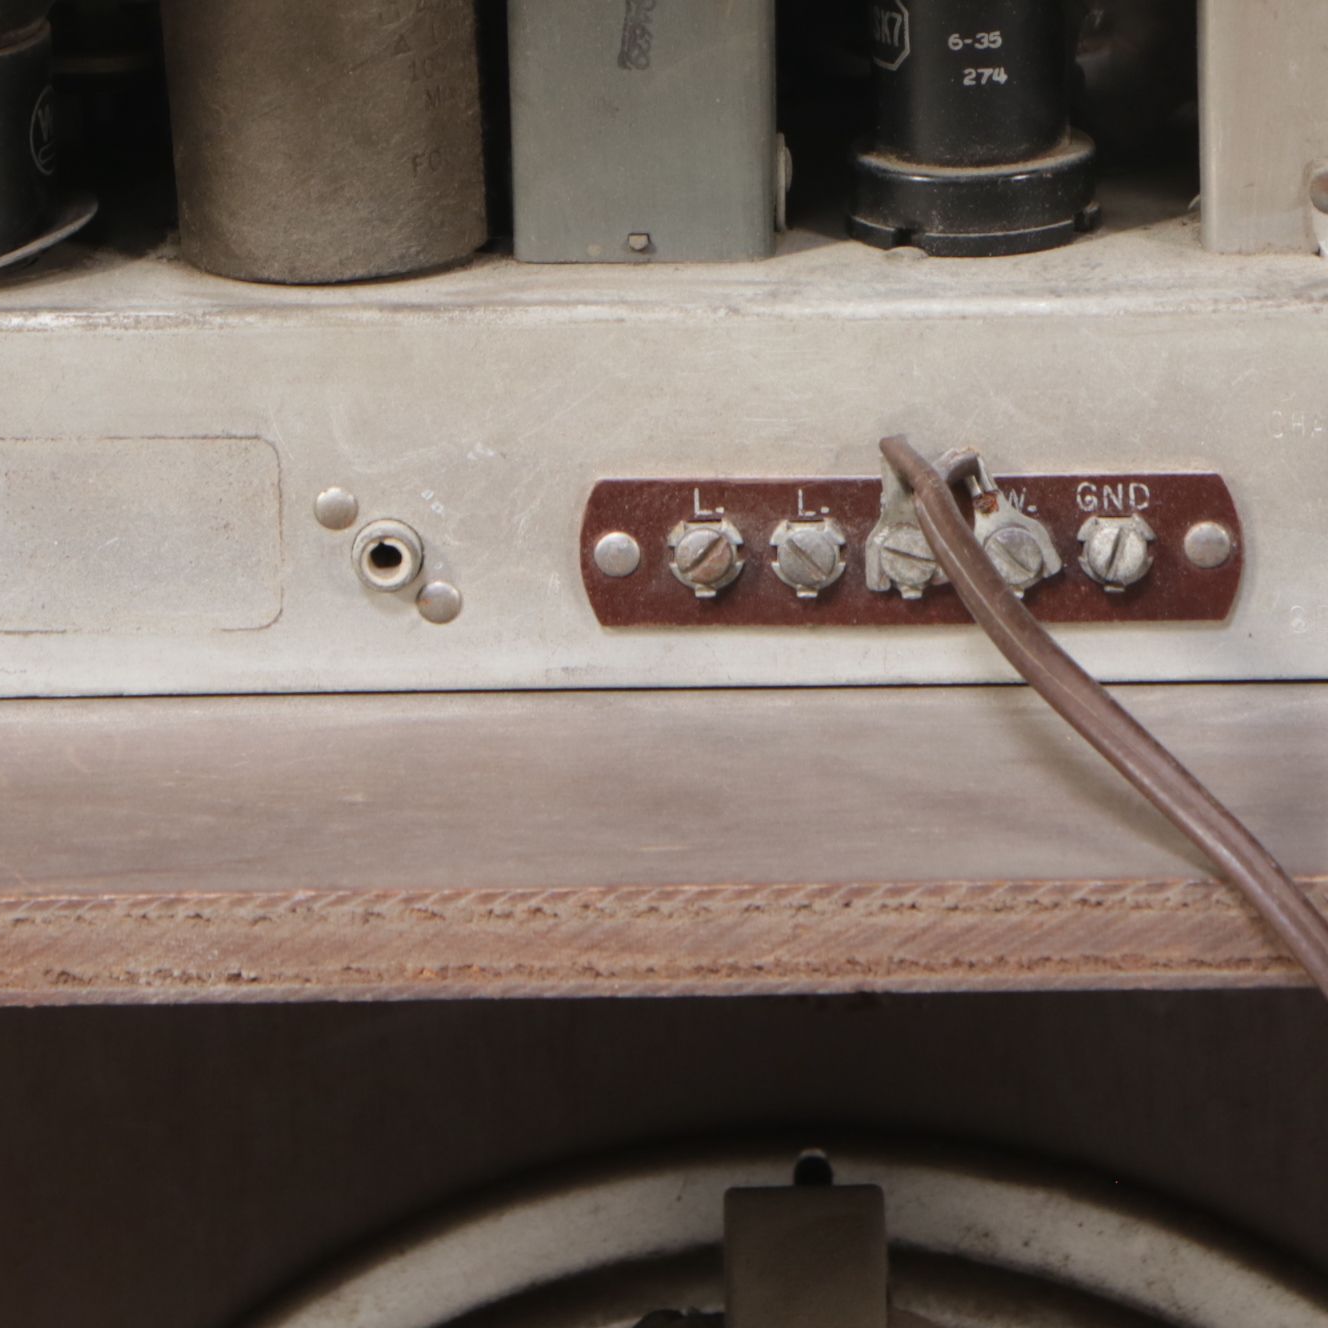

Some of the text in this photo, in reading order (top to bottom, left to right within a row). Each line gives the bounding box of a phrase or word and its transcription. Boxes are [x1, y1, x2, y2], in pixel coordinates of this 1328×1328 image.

[946, 30, 1003, 52] 6-35
[962, 65, 1008, 87] 274
[693, 486, 725, 518] L.
[797, 486, 829, 518] L.
[1075, 481, 1150, 511] GND
